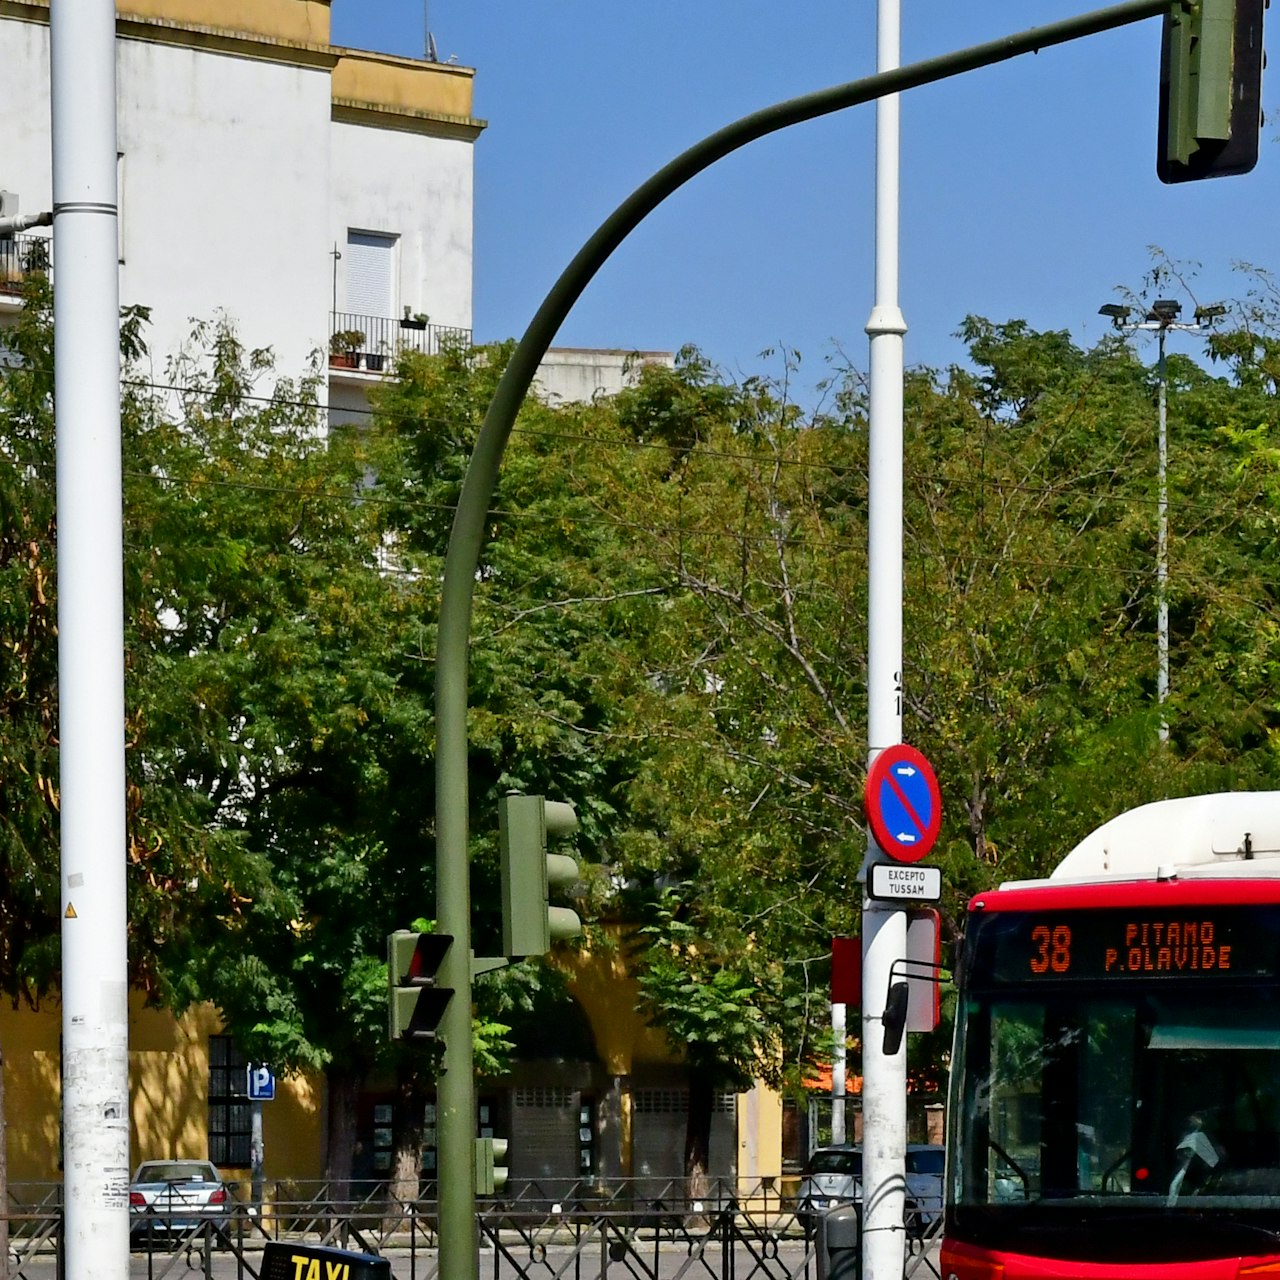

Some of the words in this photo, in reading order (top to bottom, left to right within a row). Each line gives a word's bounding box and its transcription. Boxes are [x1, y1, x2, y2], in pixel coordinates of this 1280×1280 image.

[888, 869, 926, 882] EXCEPTO
[889, 883, 925, 896] TUSSAM
[1126, 921, 1214, 946] PITAMO
[1030, 925, 1071, 972] 38
[1105, 946, 1231, 971] P.OLAVIDE
[253, 1067, 270, 1096] P
